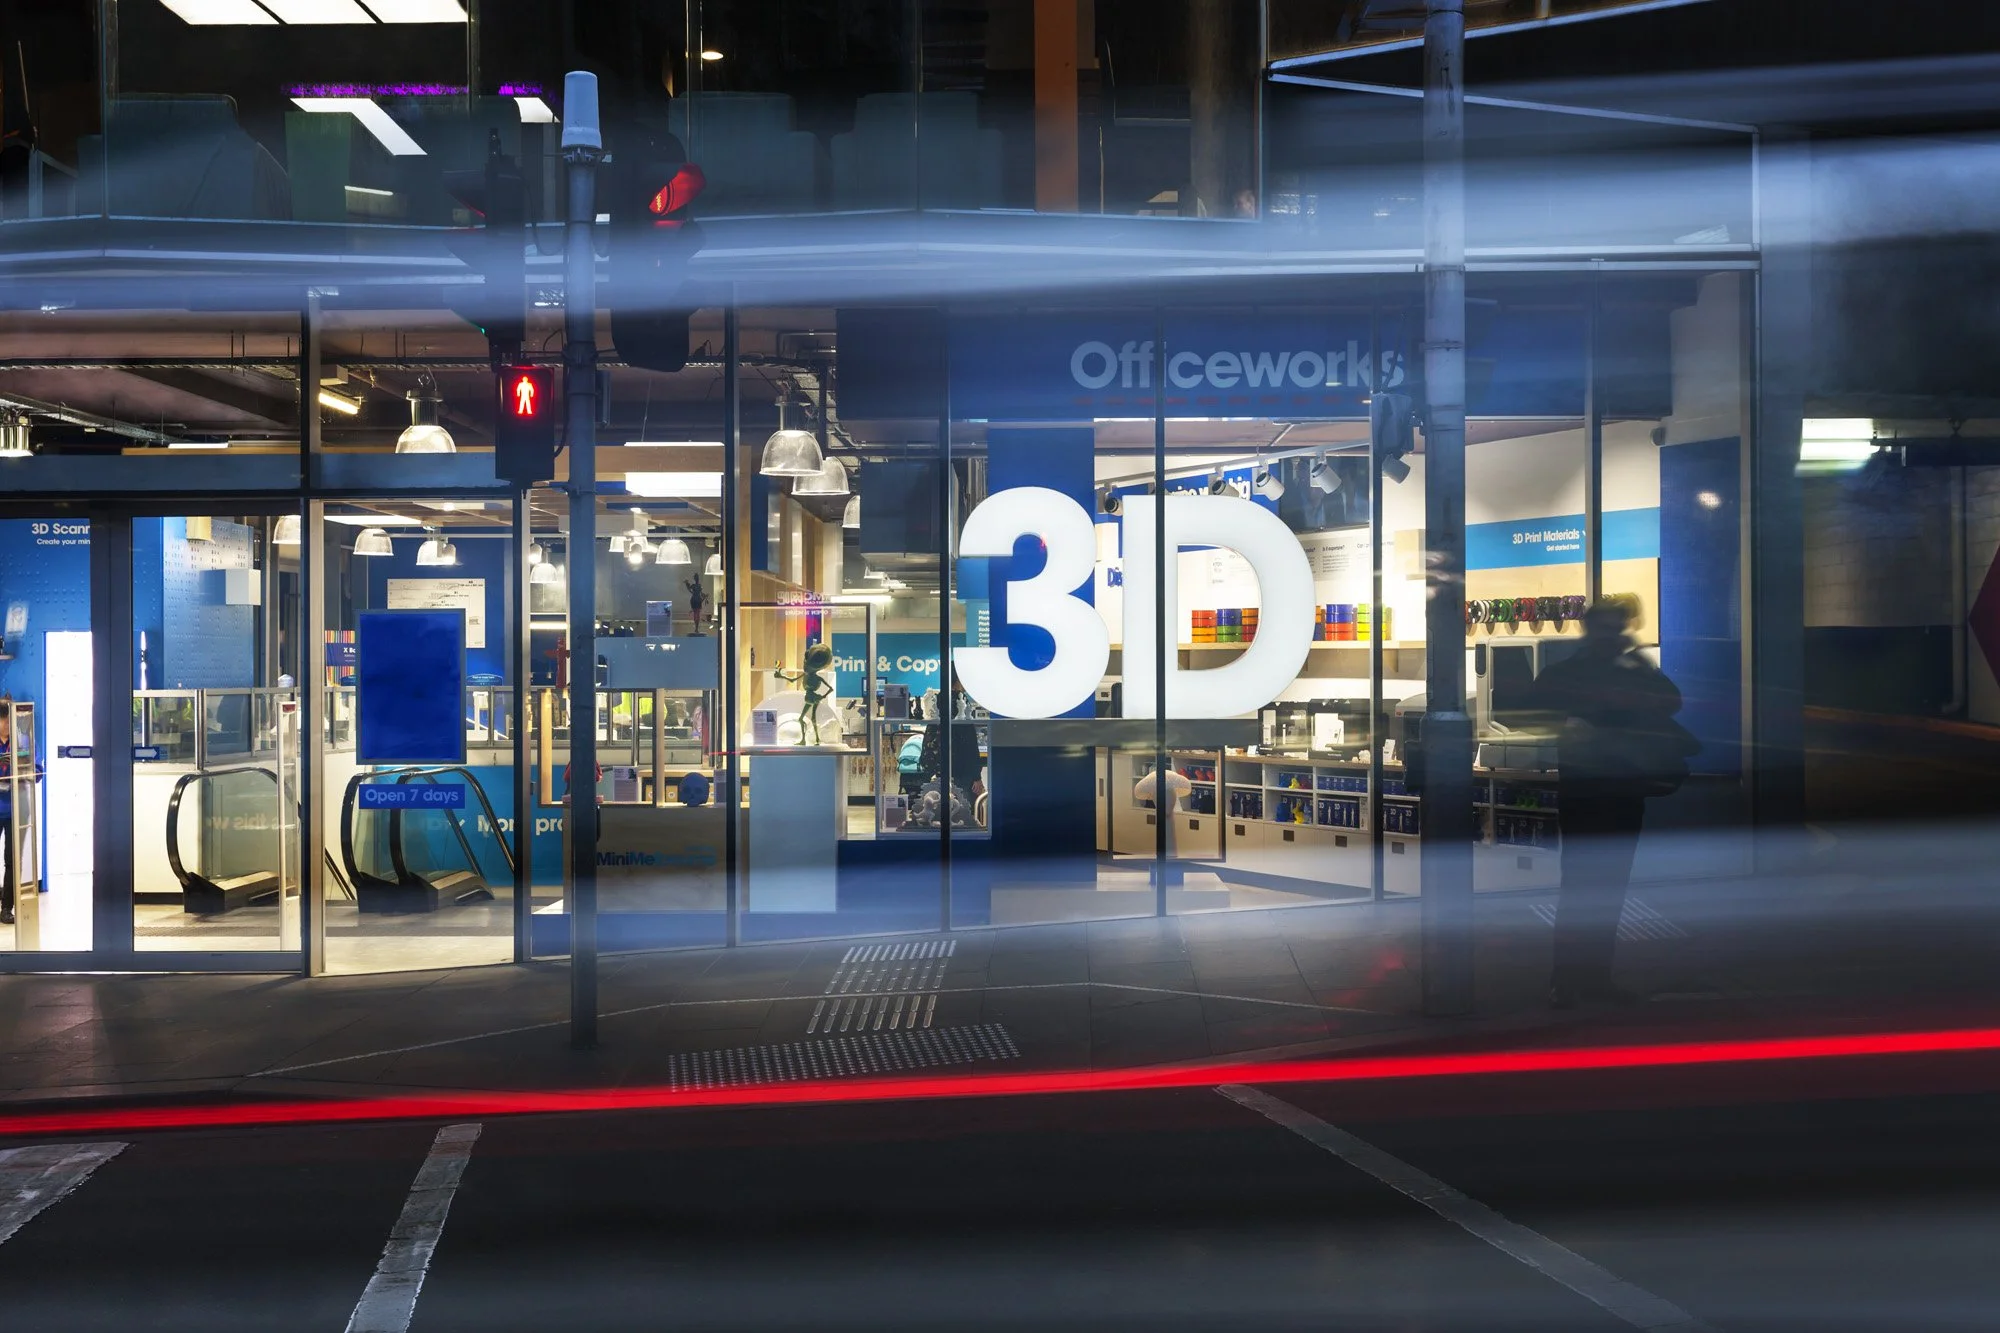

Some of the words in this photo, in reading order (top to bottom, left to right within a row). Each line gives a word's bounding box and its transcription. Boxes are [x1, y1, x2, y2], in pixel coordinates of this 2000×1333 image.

[31, 523, 49, 535] 3D
[1512, 533, 1523, 545] 3D
[1525, 532, 1542, 543] Print
[1543, 528, 1580, 542] Materials
[952, 486, 1316, 720] 3D
[877, 656, 891, 672] &
[896, 655, 941, 676] Cop
[365, 789, 406, 804] Open
[410, 789, 418, 801] 7
[422, 788, 459, 804] days
[477, 814, 514, 833] Mor
